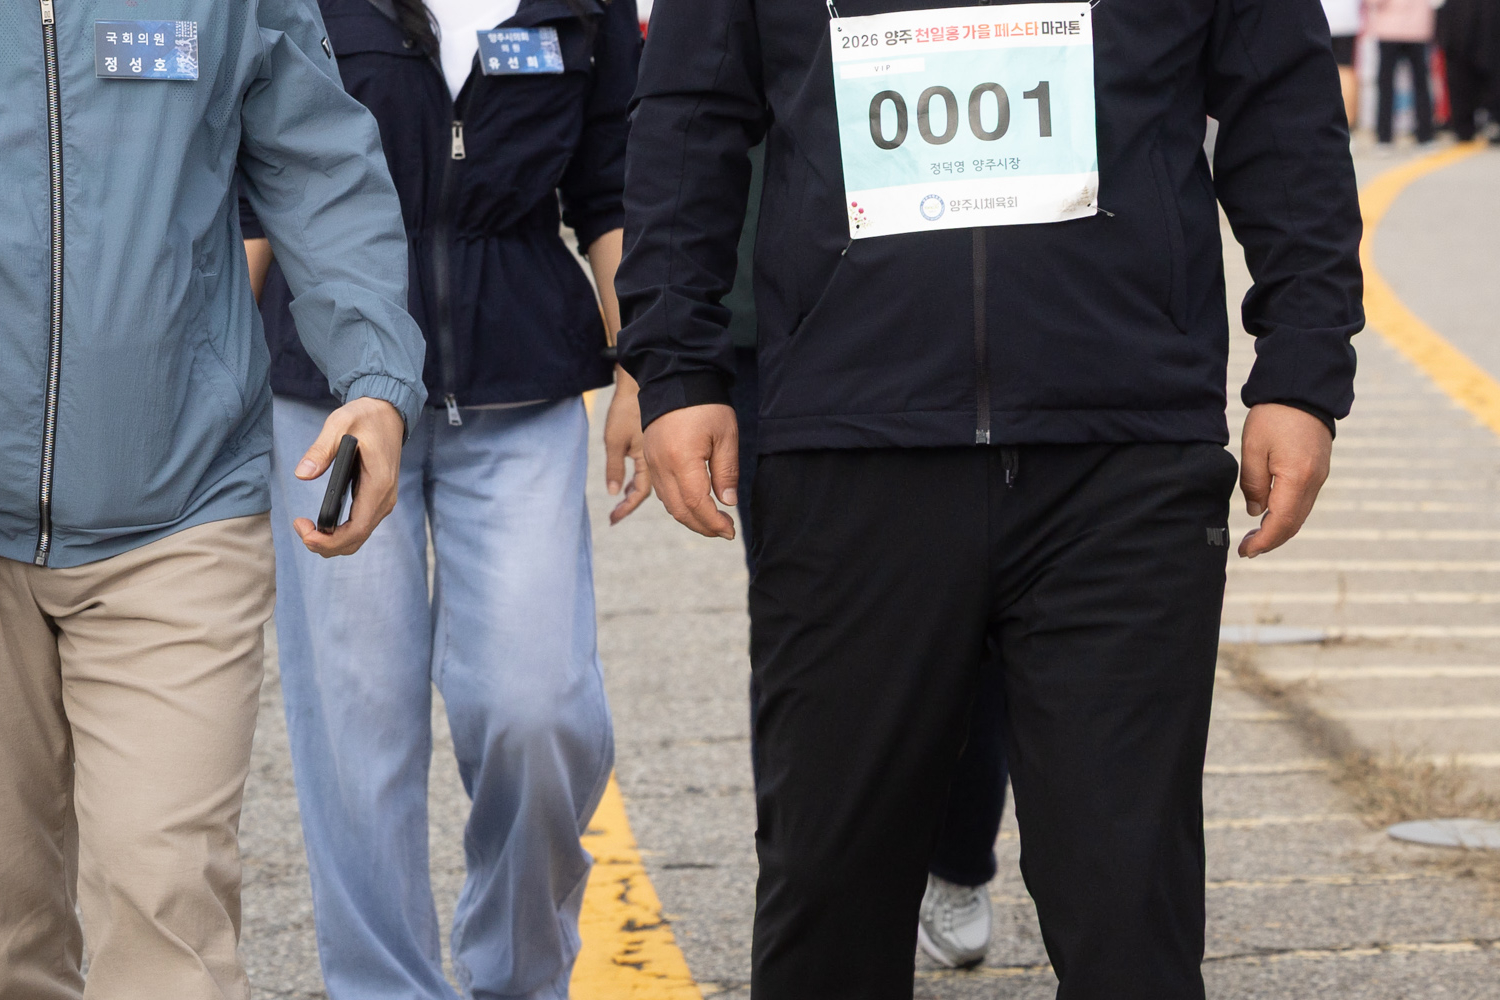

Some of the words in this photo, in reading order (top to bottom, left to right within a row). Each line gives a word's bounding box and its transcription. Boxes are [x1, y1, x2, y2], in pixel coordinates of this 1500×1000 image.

[105, 31, 165, 46] 국회의원
[842, 33, 879, 49] 2026
[884, 28, 913, 46] 양주
[915, 25, 960, 43] 천일홍
[962, 23, 991, 40] 가을
[994, 21, 1039, 37] 페스타
[1041, 20, 1081, 35] 마라톤
[104, 56, 168, 73] 정성호
[874, 64, 891, 72] VIP
[868, 80, 1052, 150] 0001
[930, 160, 965, 175] 정덕영
[972, 157, 1021, 172] 양주시장
[949, 196, 1018, 212] 양주시체육회
